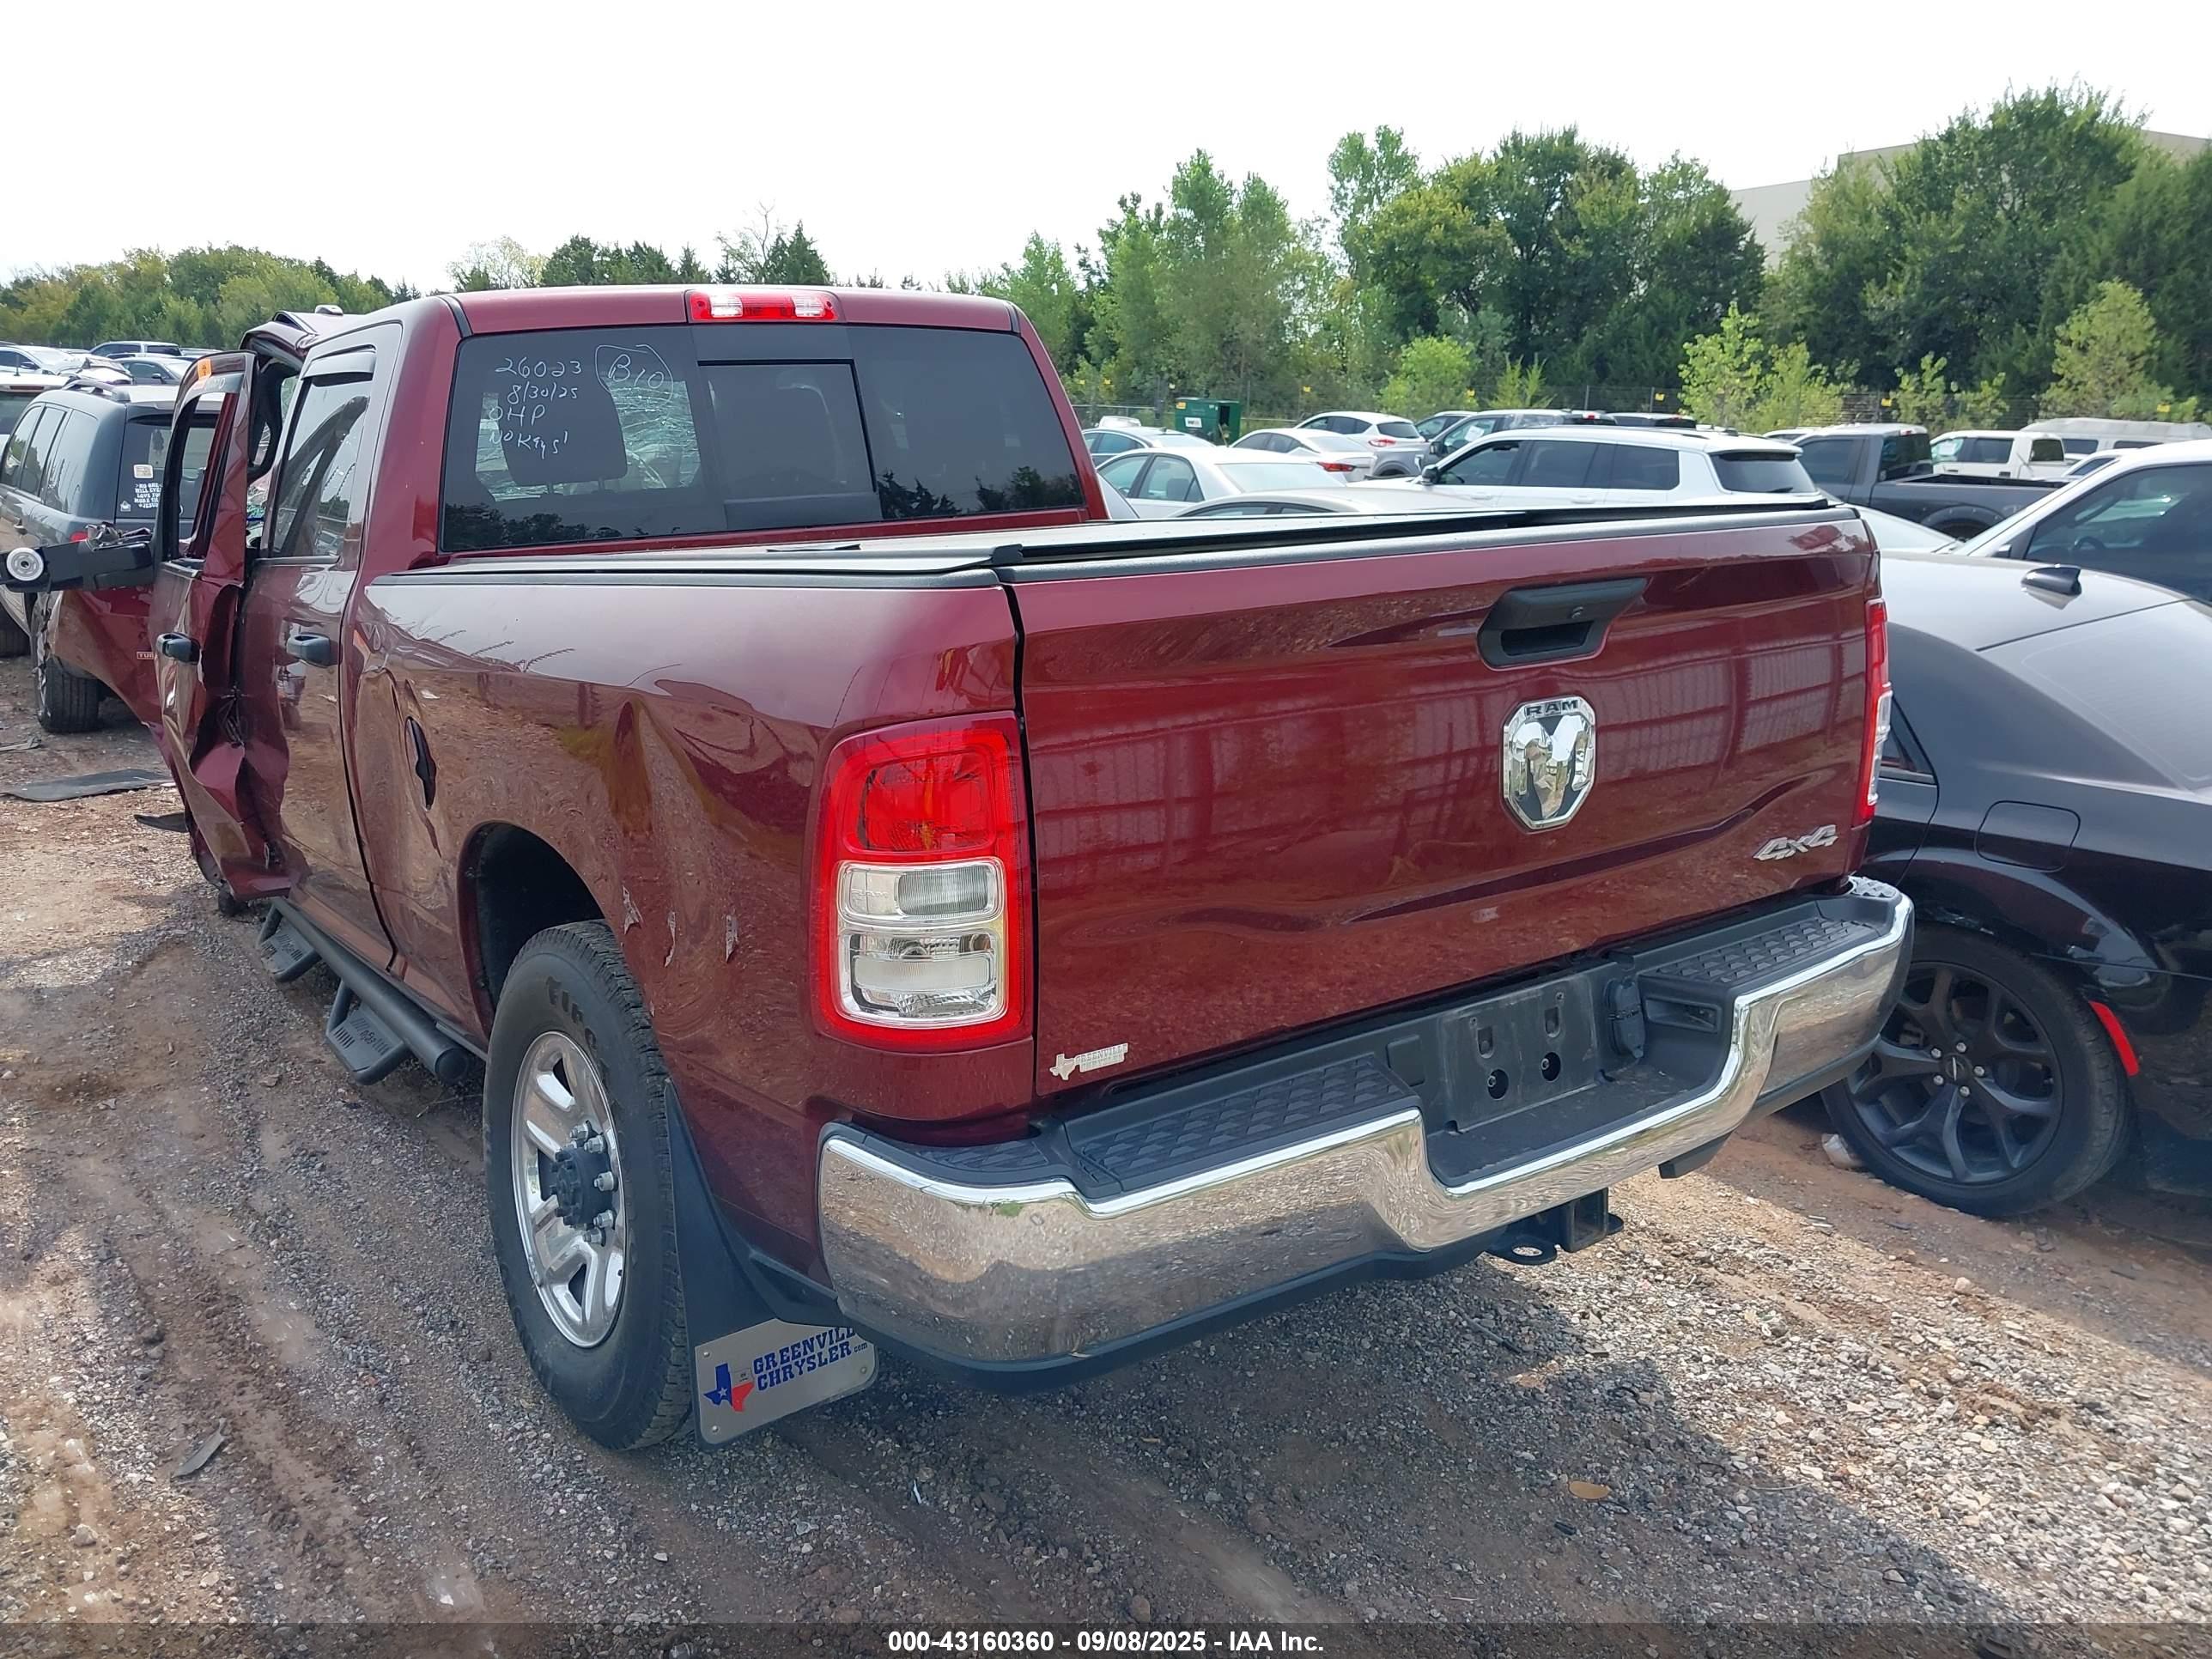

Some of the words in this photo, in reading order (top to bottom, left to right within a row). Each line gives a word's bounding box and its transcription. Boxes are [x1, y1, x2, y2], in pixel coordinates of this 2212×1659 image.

[495, 356, 582, 378] 26023
[507, 381, 578, 404] 8/30/25
[1525, 699, 1579, 716] RAM
[752, 1327, 856, 1375] GREENVILL
[757, 1340, 852, 1391] CHRYSLER
